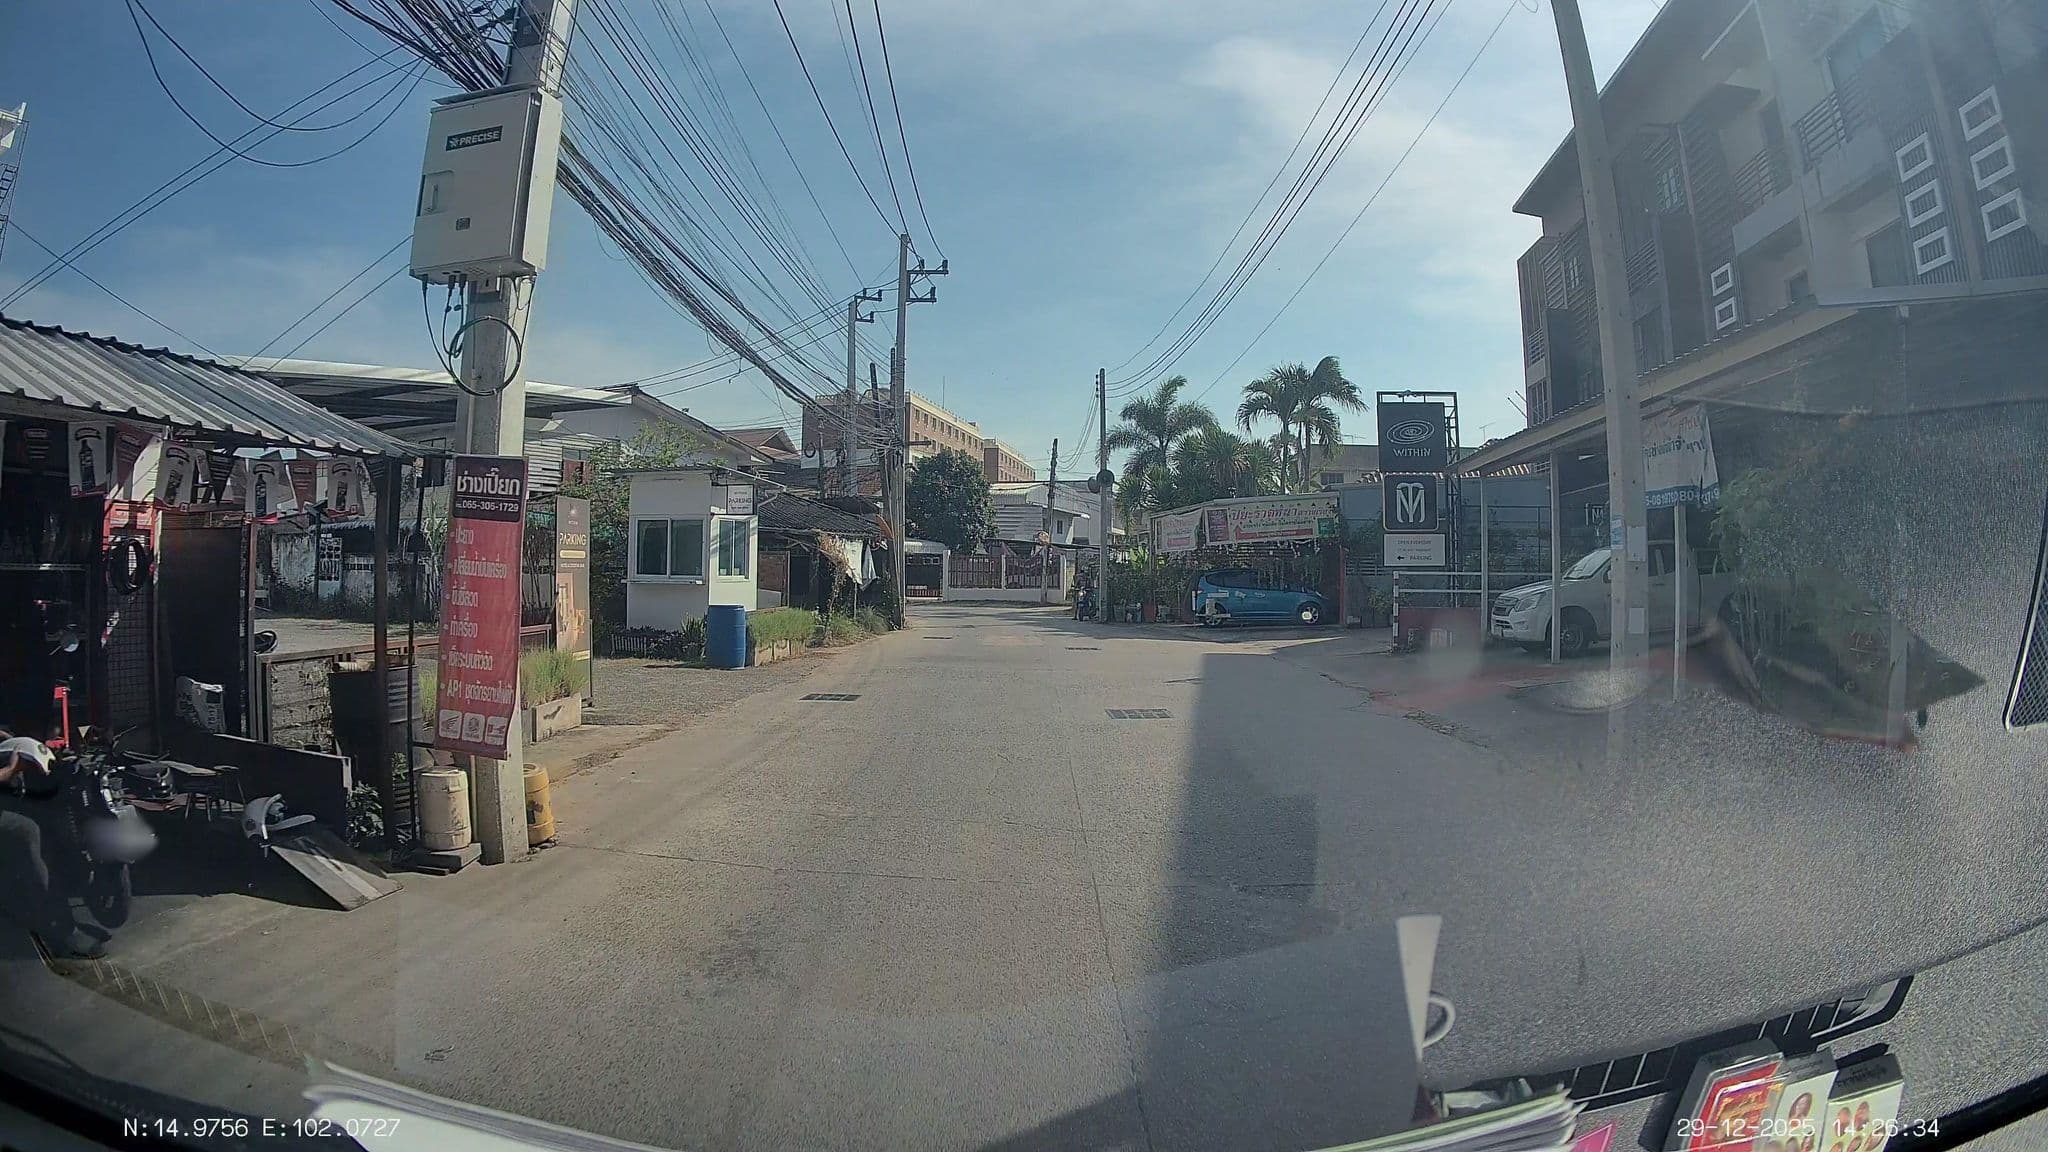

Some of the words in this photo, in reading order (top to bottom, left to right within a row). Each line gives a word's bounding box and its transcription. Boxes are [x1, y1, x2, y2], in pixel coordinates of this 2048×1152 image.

[459, 131, 500, 146] PRECISE
[1393, 448, 1431, 457] WITHIN
[456, 467, 520, 496] ช่างเปี๊ยก
[559, 532, 587, 546] PARKING
